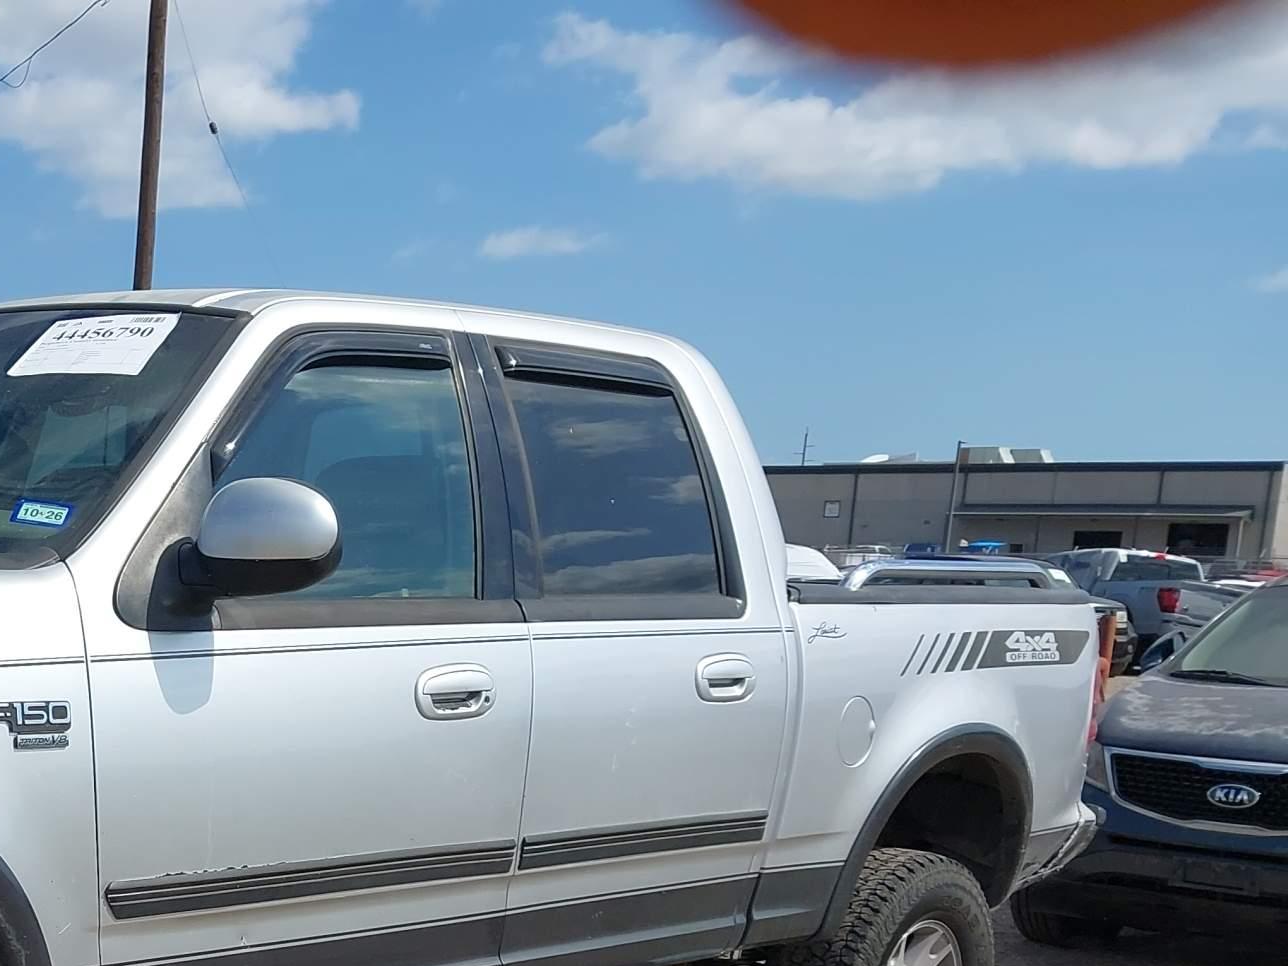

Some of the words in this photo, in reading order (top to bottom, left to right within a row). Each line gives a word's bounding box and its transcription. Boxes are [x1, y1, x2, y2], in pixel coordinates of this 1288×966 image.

[52, 326, 155, 341] 44456790
[1010, 653, 1028, 661] OFF
[1031, 652, 1057, 660] ROAD
[51, 735, 68, 746] V8
[1214, 787, 1249, 804] KIA
